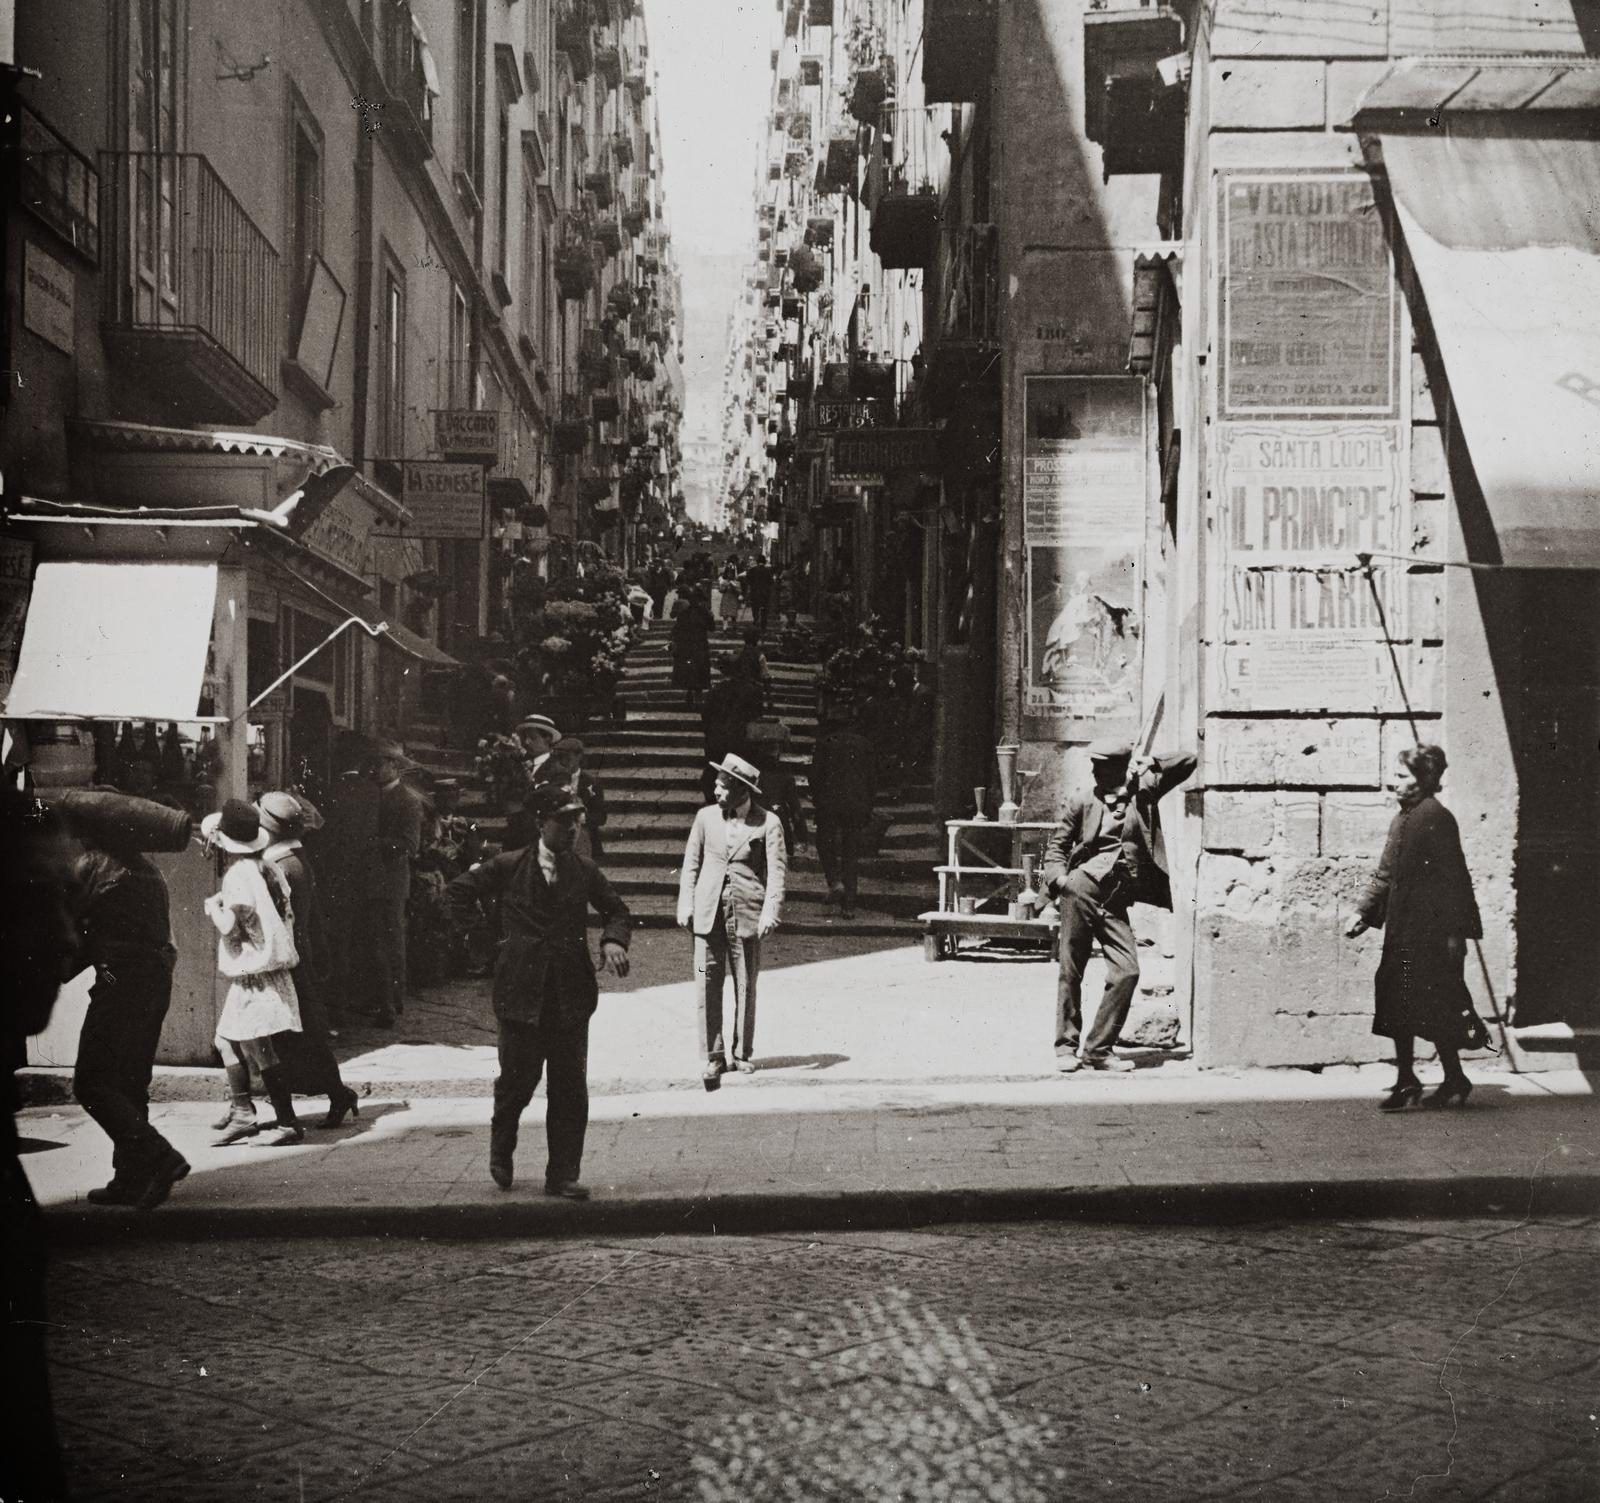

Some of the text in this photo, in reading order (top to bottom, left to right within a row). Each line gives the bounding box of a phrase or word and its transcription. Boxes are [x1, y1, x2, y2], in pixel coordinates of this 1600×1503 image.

[1259, 440, 1322, 469] SANTA
[1329, 439, 1385, 468] LUCIA
[407, 469, 482, 493] LA SENESE
[1231, 486, 1388, 551] IL PRINCIPE
